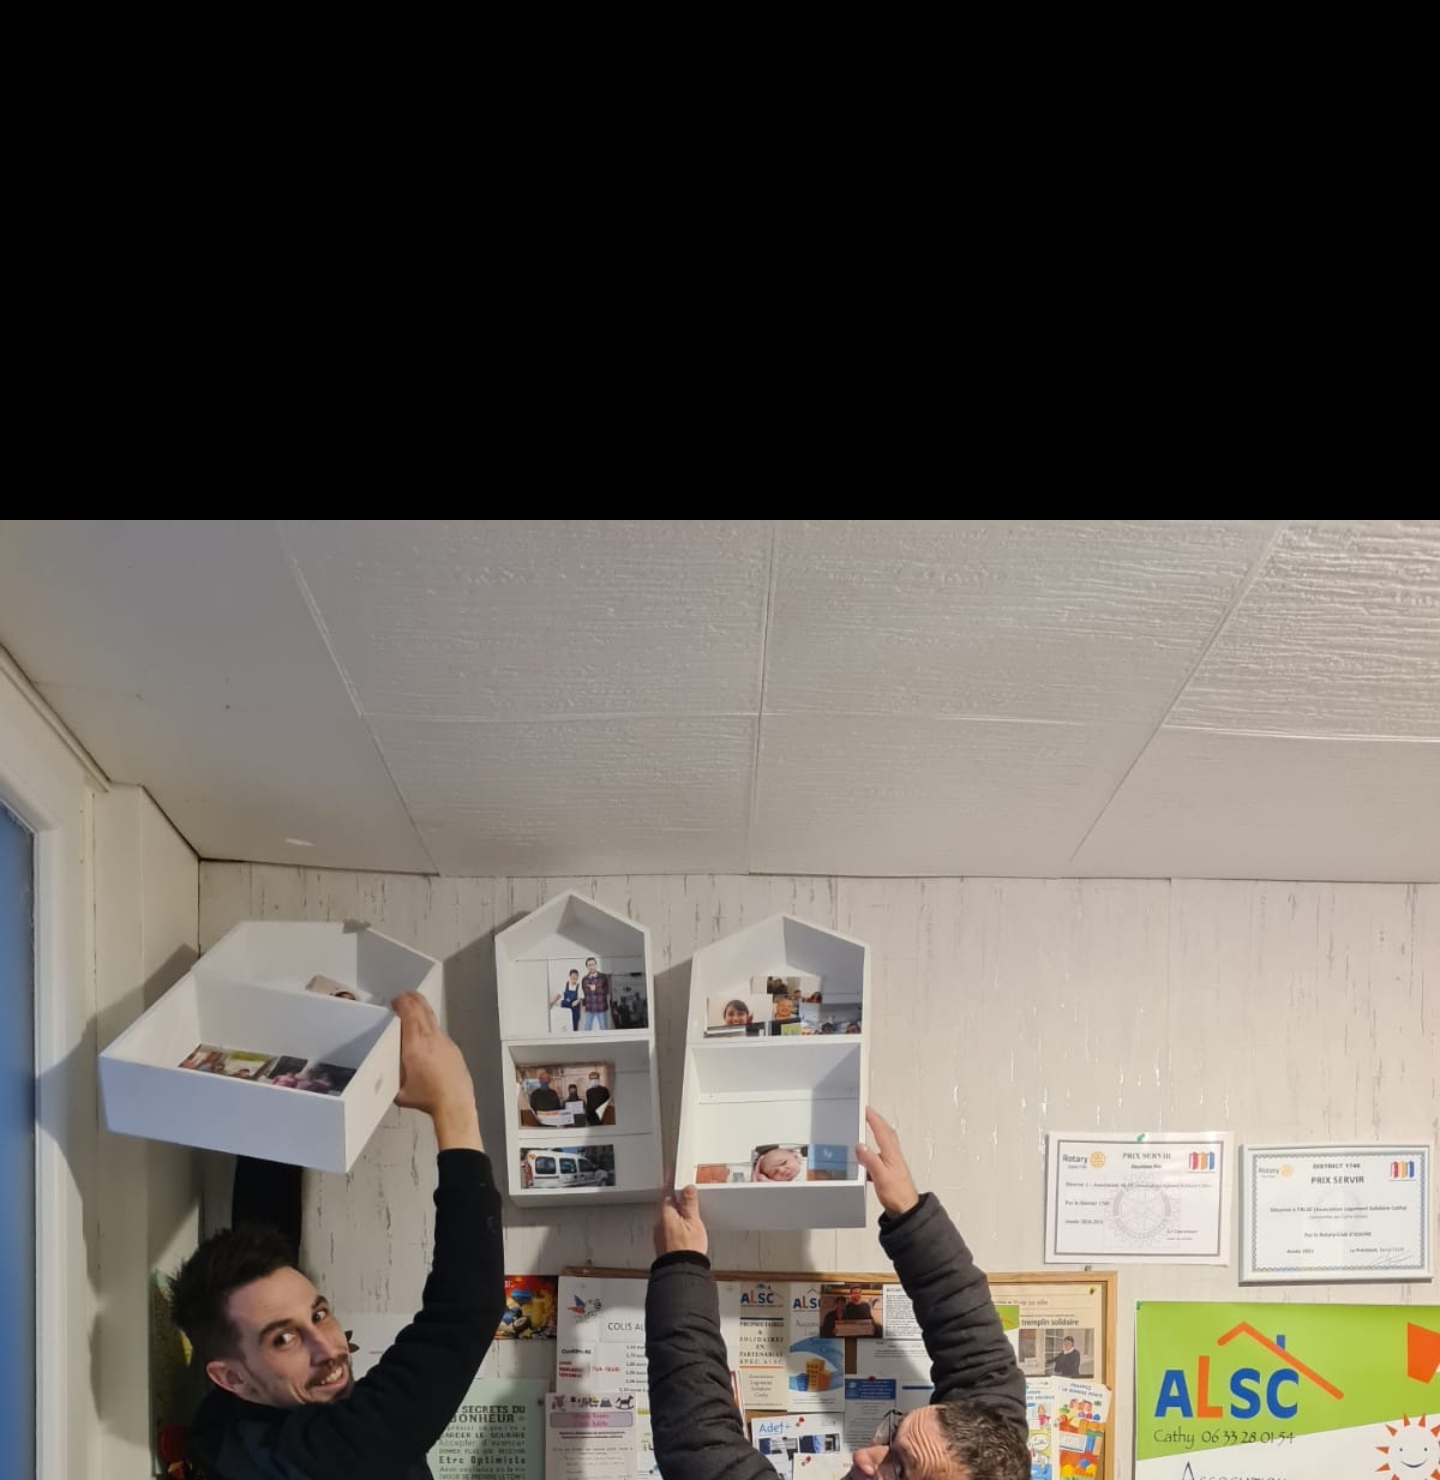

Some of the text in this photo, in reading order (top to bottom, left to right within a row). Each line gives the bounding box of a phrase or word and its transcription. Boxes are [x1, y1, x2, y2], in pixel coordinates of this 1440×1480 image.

[1063, 1154, 1088, 1165] Rotary
[1122, 1152, 1141, 1160] PRIX
[1310, 1175, 1365, 1185] PRIX SERVIR
[741, 1290, 775, 1305] ALSC
[793, 1295, 821, 1309] ALS
[607, 1322, 633, 1331] COLIS
[1021, 1317, 1080, 1327] tremplin solidaire
[1154, 1355, 1299, 1419] ALSC
[461, 1405, 526, 1414] SECRETS DU
[1153, 1426, 1195, 1450] Cathy
[1201, 1428, 1220, 1443] 06
[1223, 1430, 1238, 1445] 33
[1241, 1430, 1257, 1444] 28
[470, 1455, 527, 1466] Optimiste
